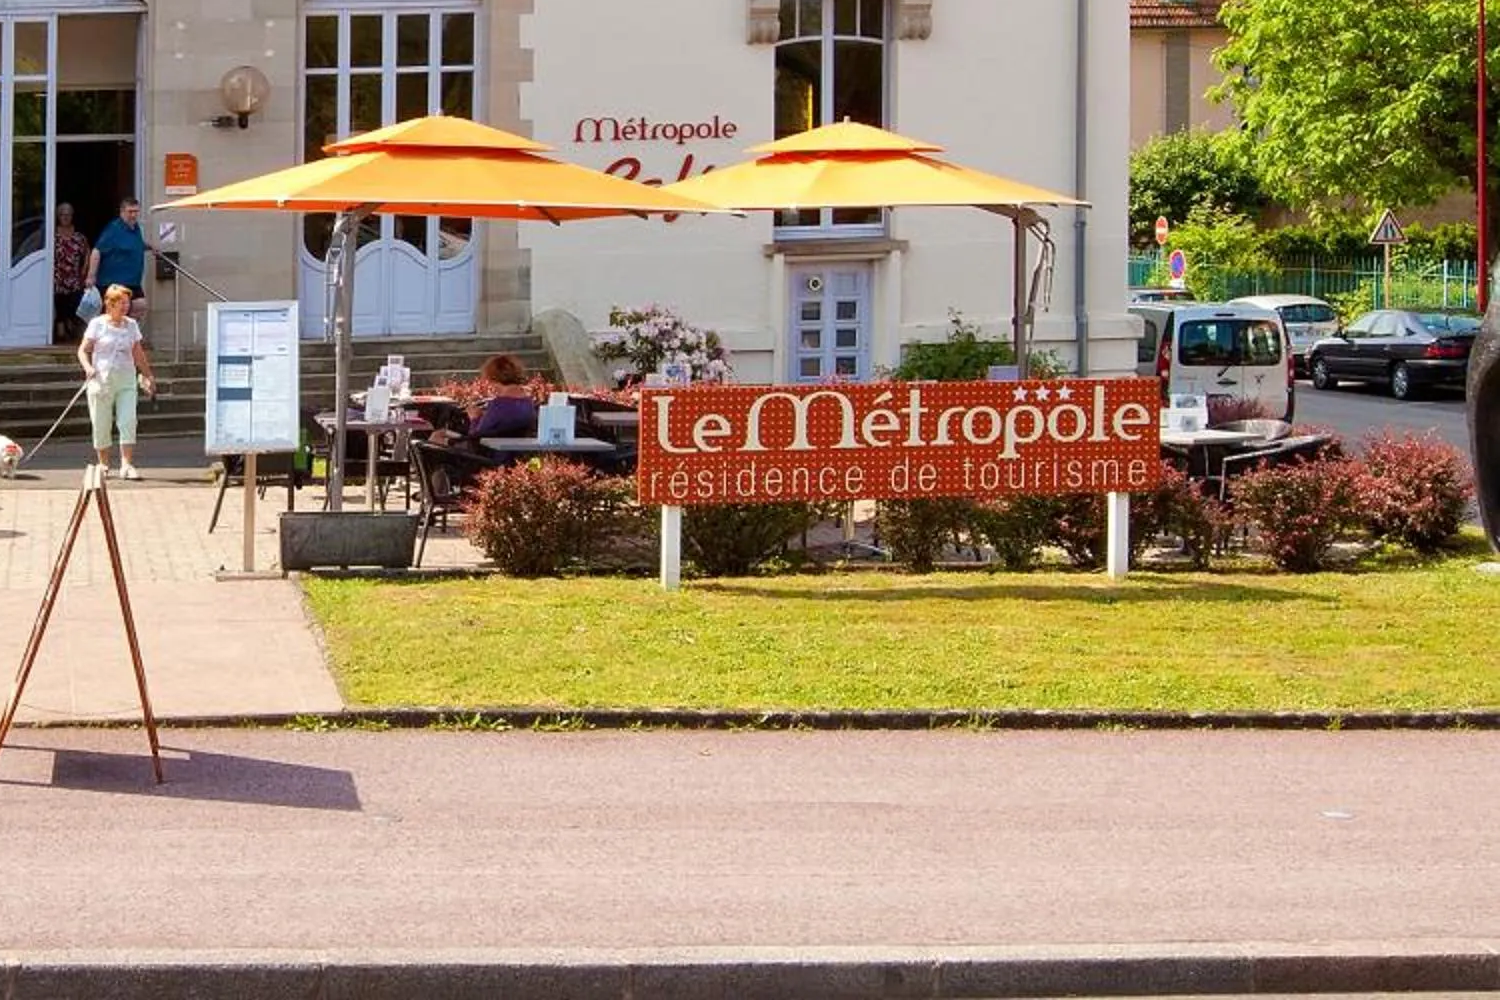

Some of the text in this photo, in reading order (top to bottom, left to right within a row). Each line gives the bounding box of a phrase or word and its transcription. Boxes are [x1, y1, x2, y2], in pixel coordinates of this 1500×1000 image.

[574, 116, 737, 144] Métropole
[651, 385, 1151, 459] Le Métropole
[650, 454, 1148, 501] résidence de tourisme
